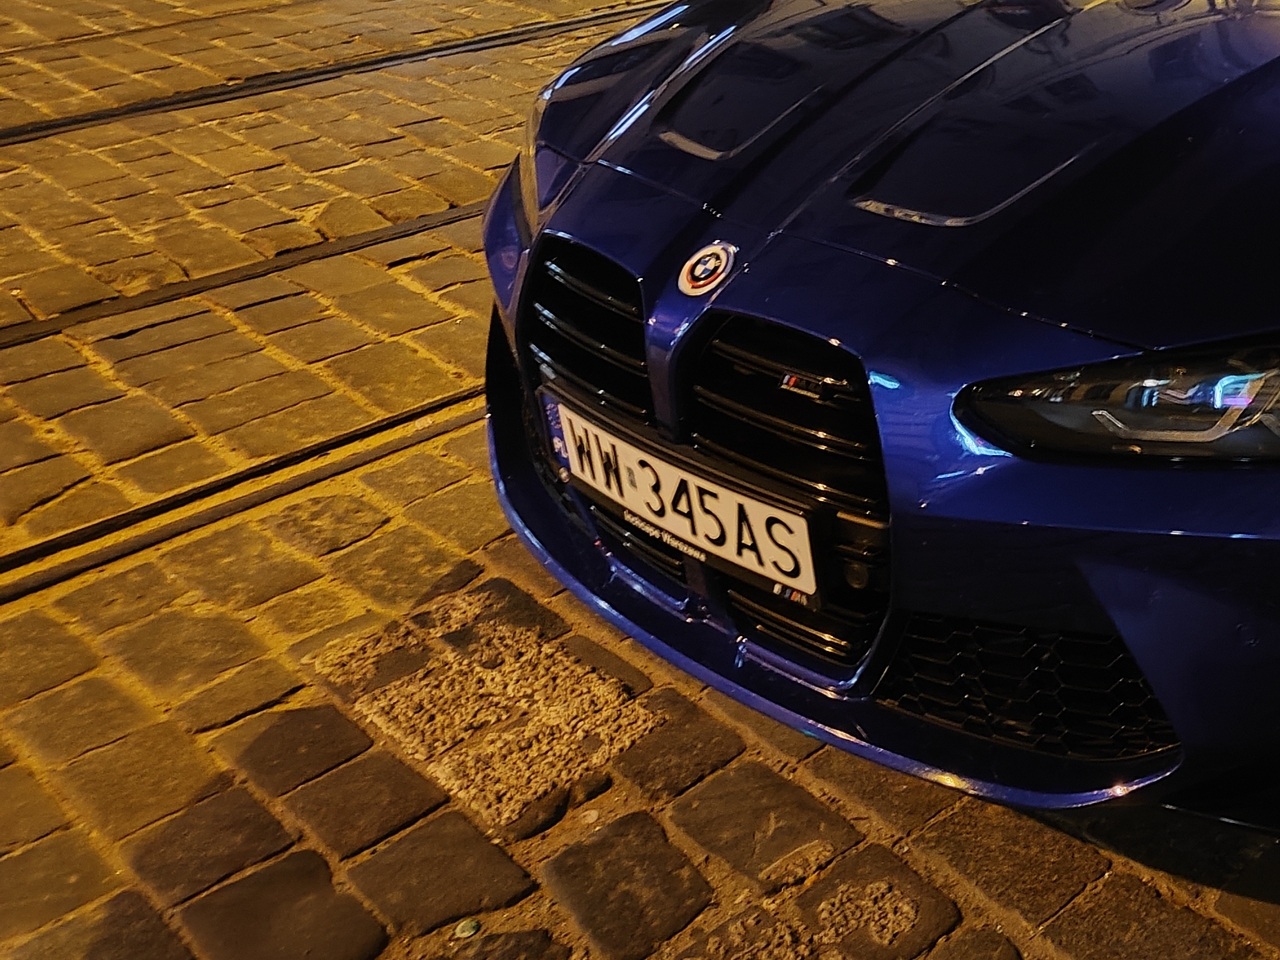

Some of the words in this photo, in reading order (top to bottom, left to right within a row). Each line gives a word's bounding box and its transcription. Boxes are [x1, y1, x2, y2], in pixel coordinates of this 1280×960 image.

[552, 435, 569, 459] PL
[567, 416, 624, 499] WW
[637, 458, 802, 579] 345AS
